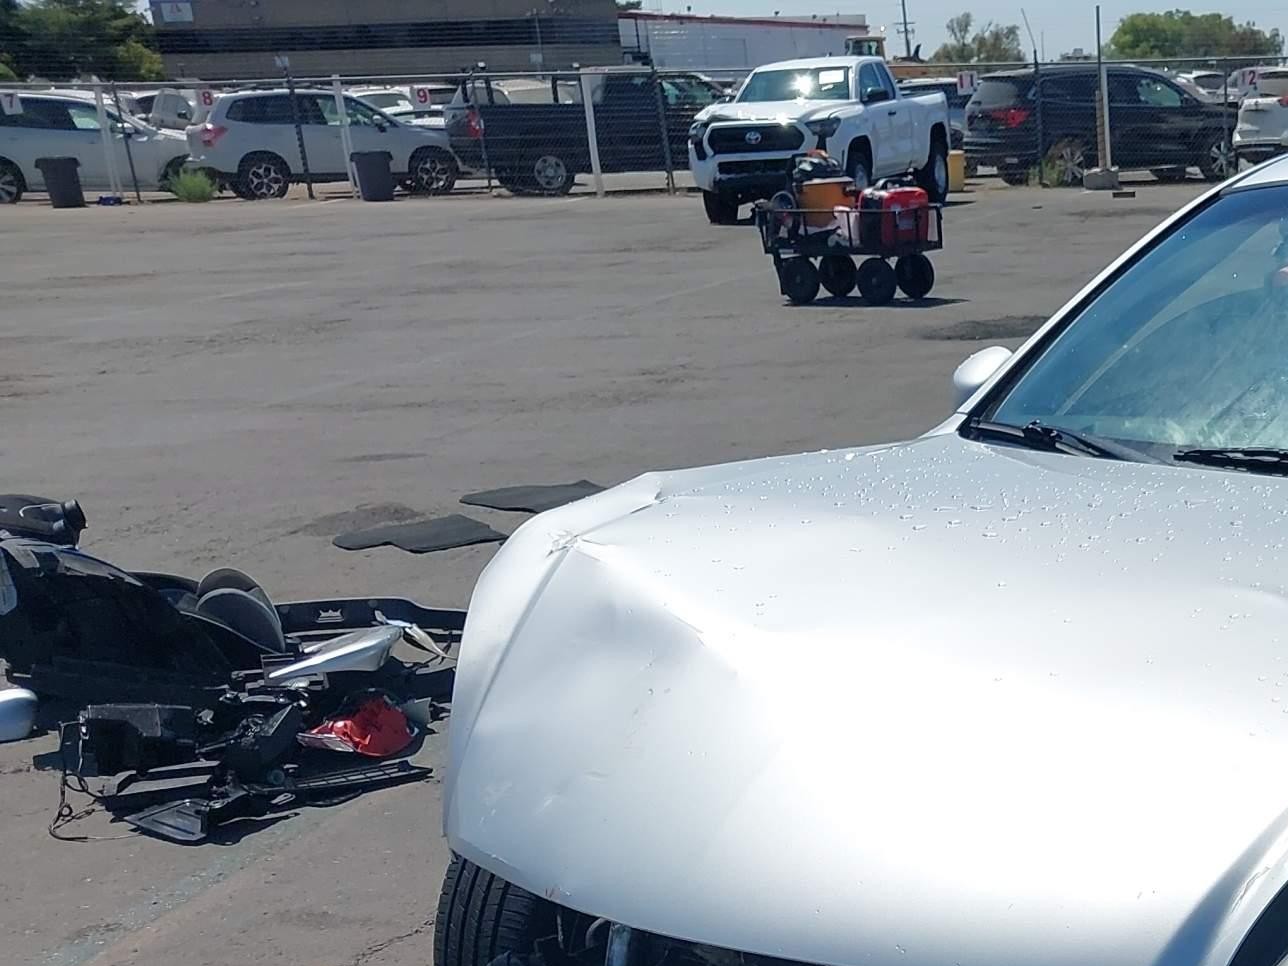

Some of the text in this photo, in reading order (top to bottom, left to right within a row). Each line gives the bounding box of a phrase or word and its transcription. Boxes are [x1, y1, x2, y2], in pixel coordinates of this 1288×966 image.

[960, 74, 974, 88] 11
[1242, 70, 1257, 86] 12
[202, 91, 213, 106] 8
[416, 88, 428, 104] 9
